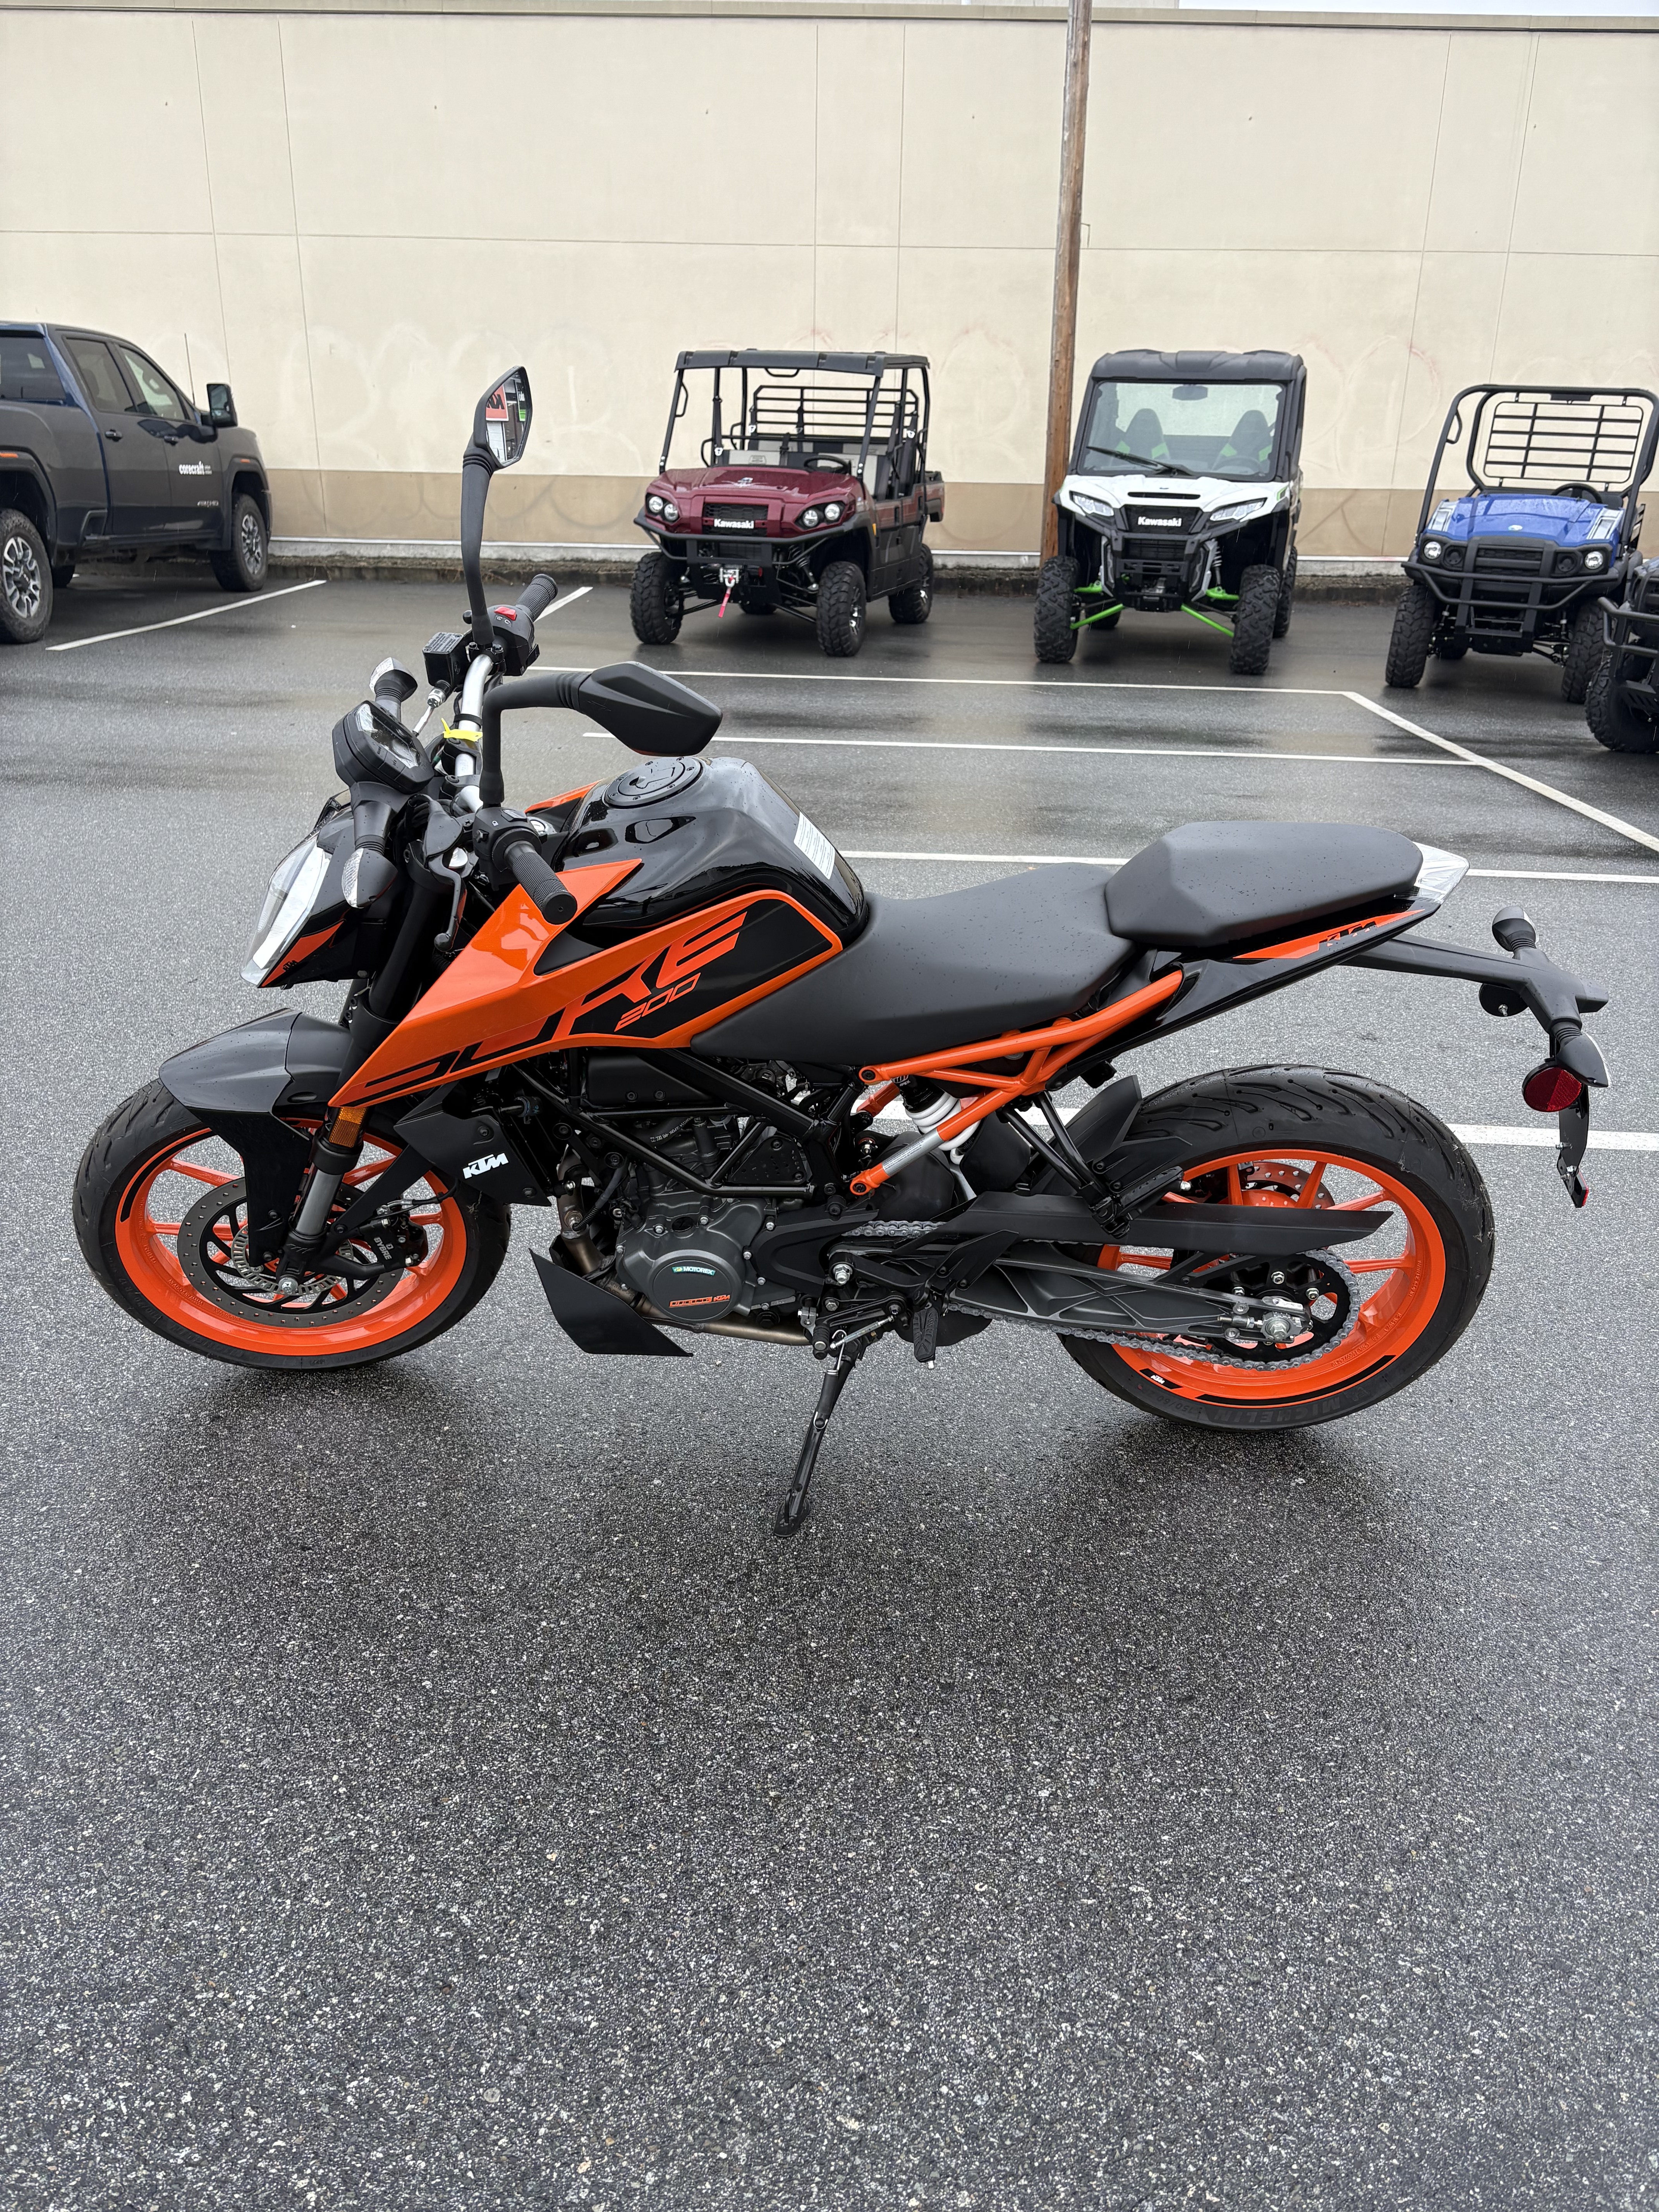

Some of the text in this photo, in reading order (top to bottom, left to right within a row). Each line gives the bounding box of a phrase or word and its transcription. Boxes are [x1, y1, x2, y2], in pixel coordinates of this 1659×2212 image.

[714, 519, 754, 529] Kawasaki
[1138, 516, 1182, 527] Kawasaki
[1319, 921, 1377, 950] KTM
[339, 911, 748, 1107] DUKE
[614, 972, 701, 1032] 200
[463, 1153, 508, 1179] KTM
[374, 1237, 392, 1260] BYBRE
[683, 1266, 713, 1275] MOTOREX
[1213, 1396, 1344, 1423] MICHELIN
